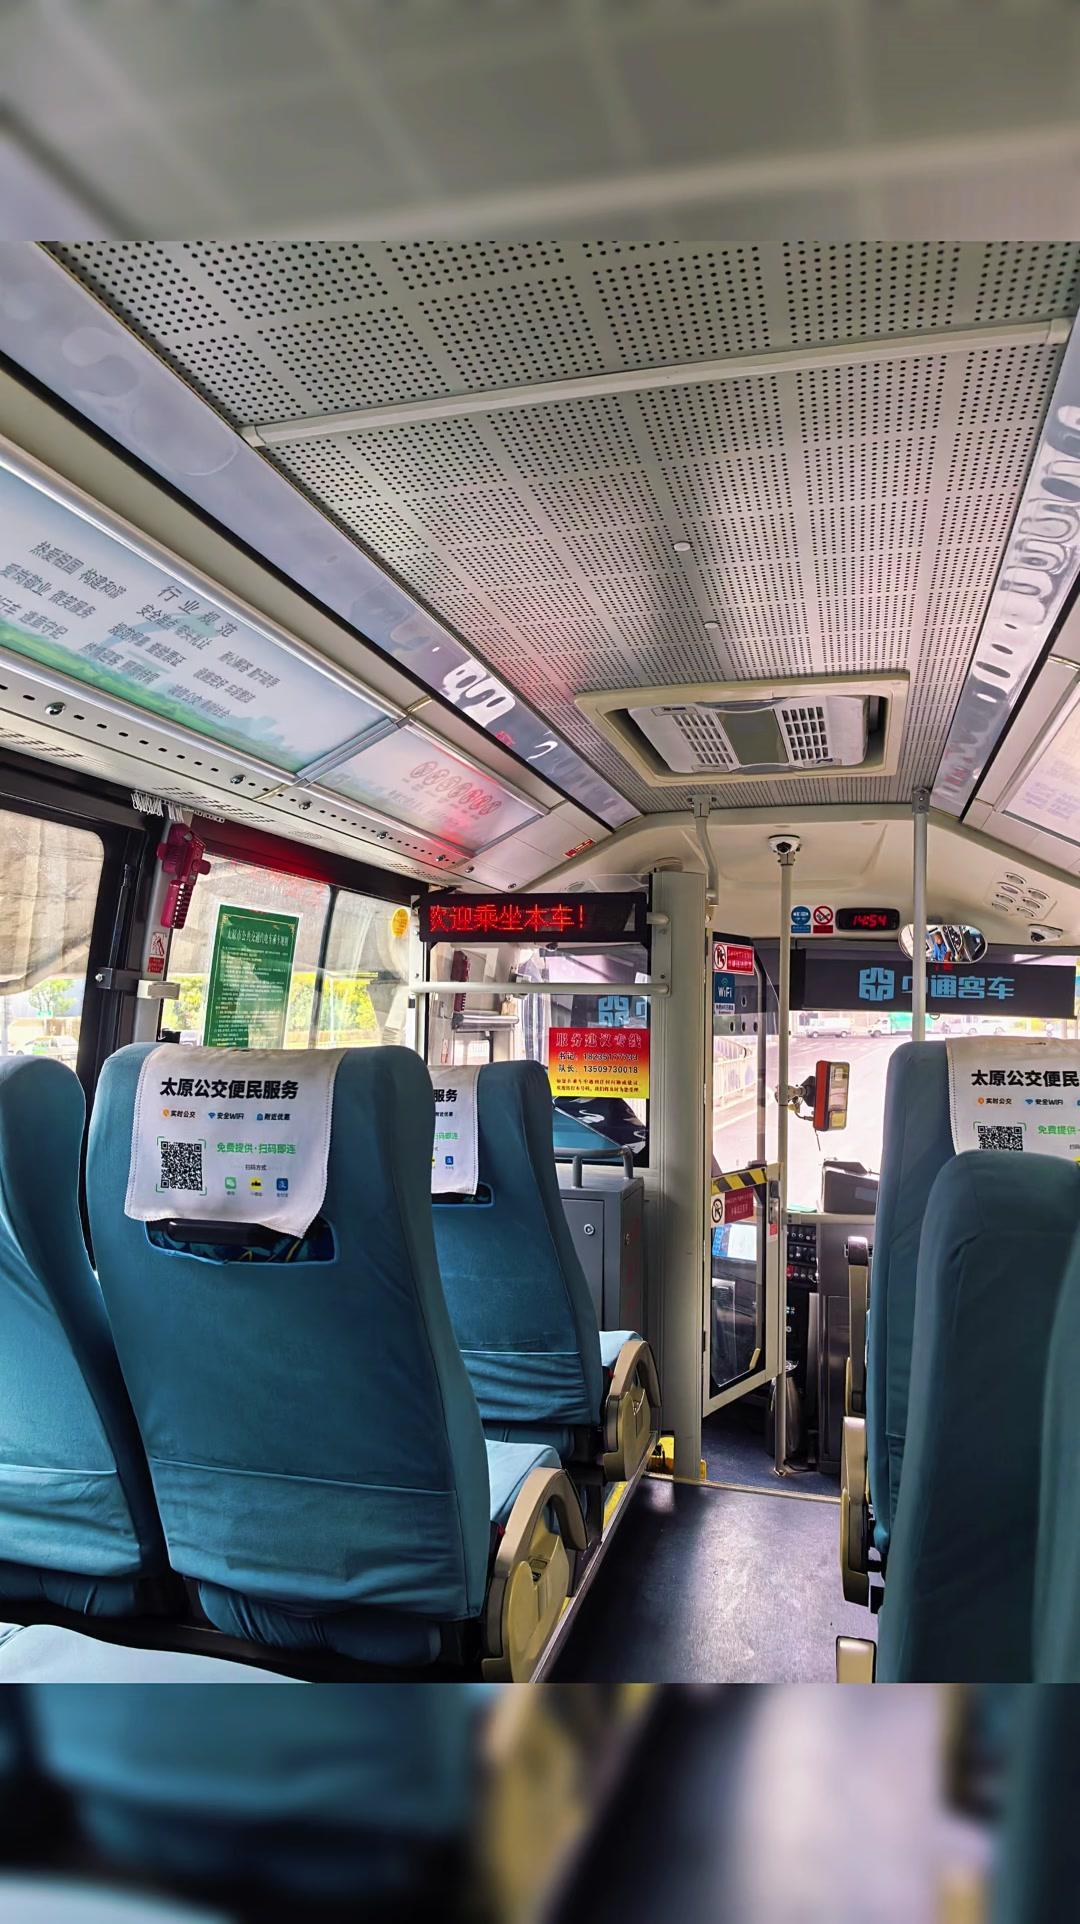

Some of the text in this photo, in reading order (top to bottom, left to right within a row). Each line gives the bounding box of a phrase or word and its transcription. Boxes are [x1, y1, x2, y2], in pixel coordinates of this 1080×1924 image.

[29, 540, 127, 599] 热爱祖国 构建和谐
[0, 563, 97, 619] 爱岗敬业 微笑服务
[157, 585, 238, 638] 行业规范
[19, 610, 69, 640] 遵章守纪
[853, 914, 887, 928] 14:54
[159, 1077, 299, 1100] 太原公交便民服务
[971, 1069, 1080, 1087] 太原公交便民
[170, 1110, 196, 1119] 实时公交
[264, 1113, 291, 1121] 附近优惠
